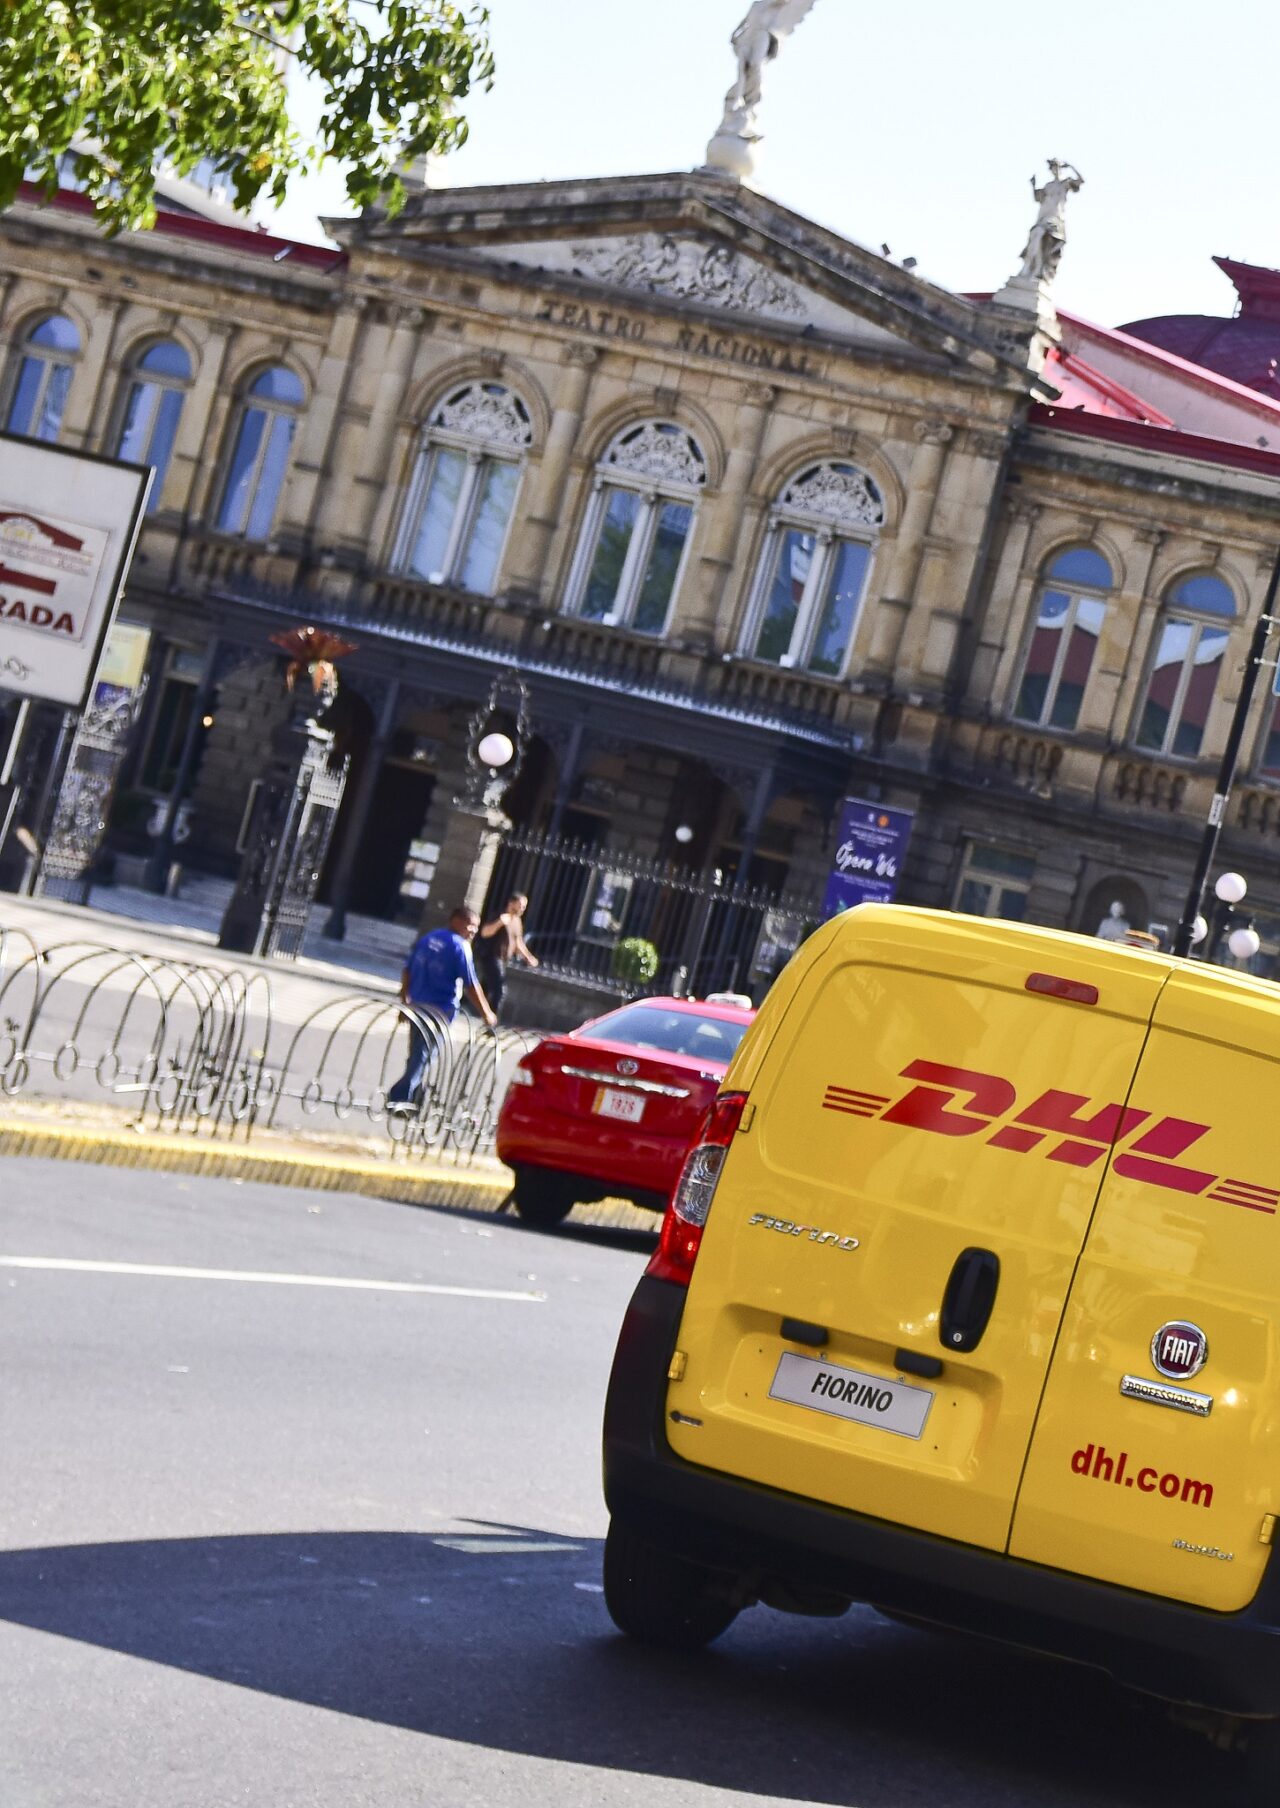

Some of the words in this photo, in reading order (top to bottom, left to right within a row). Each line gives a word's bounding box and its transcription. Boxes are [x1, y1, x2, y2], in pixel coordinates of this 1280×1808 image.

[541, 299, 646, 340] TEATRO
[675, 327, 822, 377] NACIONAL
[879, 1058, 1219, 1196] DHL
[1161, 1335, 1198, 1367] FIAT
[811, 1372, 894, 1413] FIORINO
[1071, 1443, 1214, 1508] dhl.com
